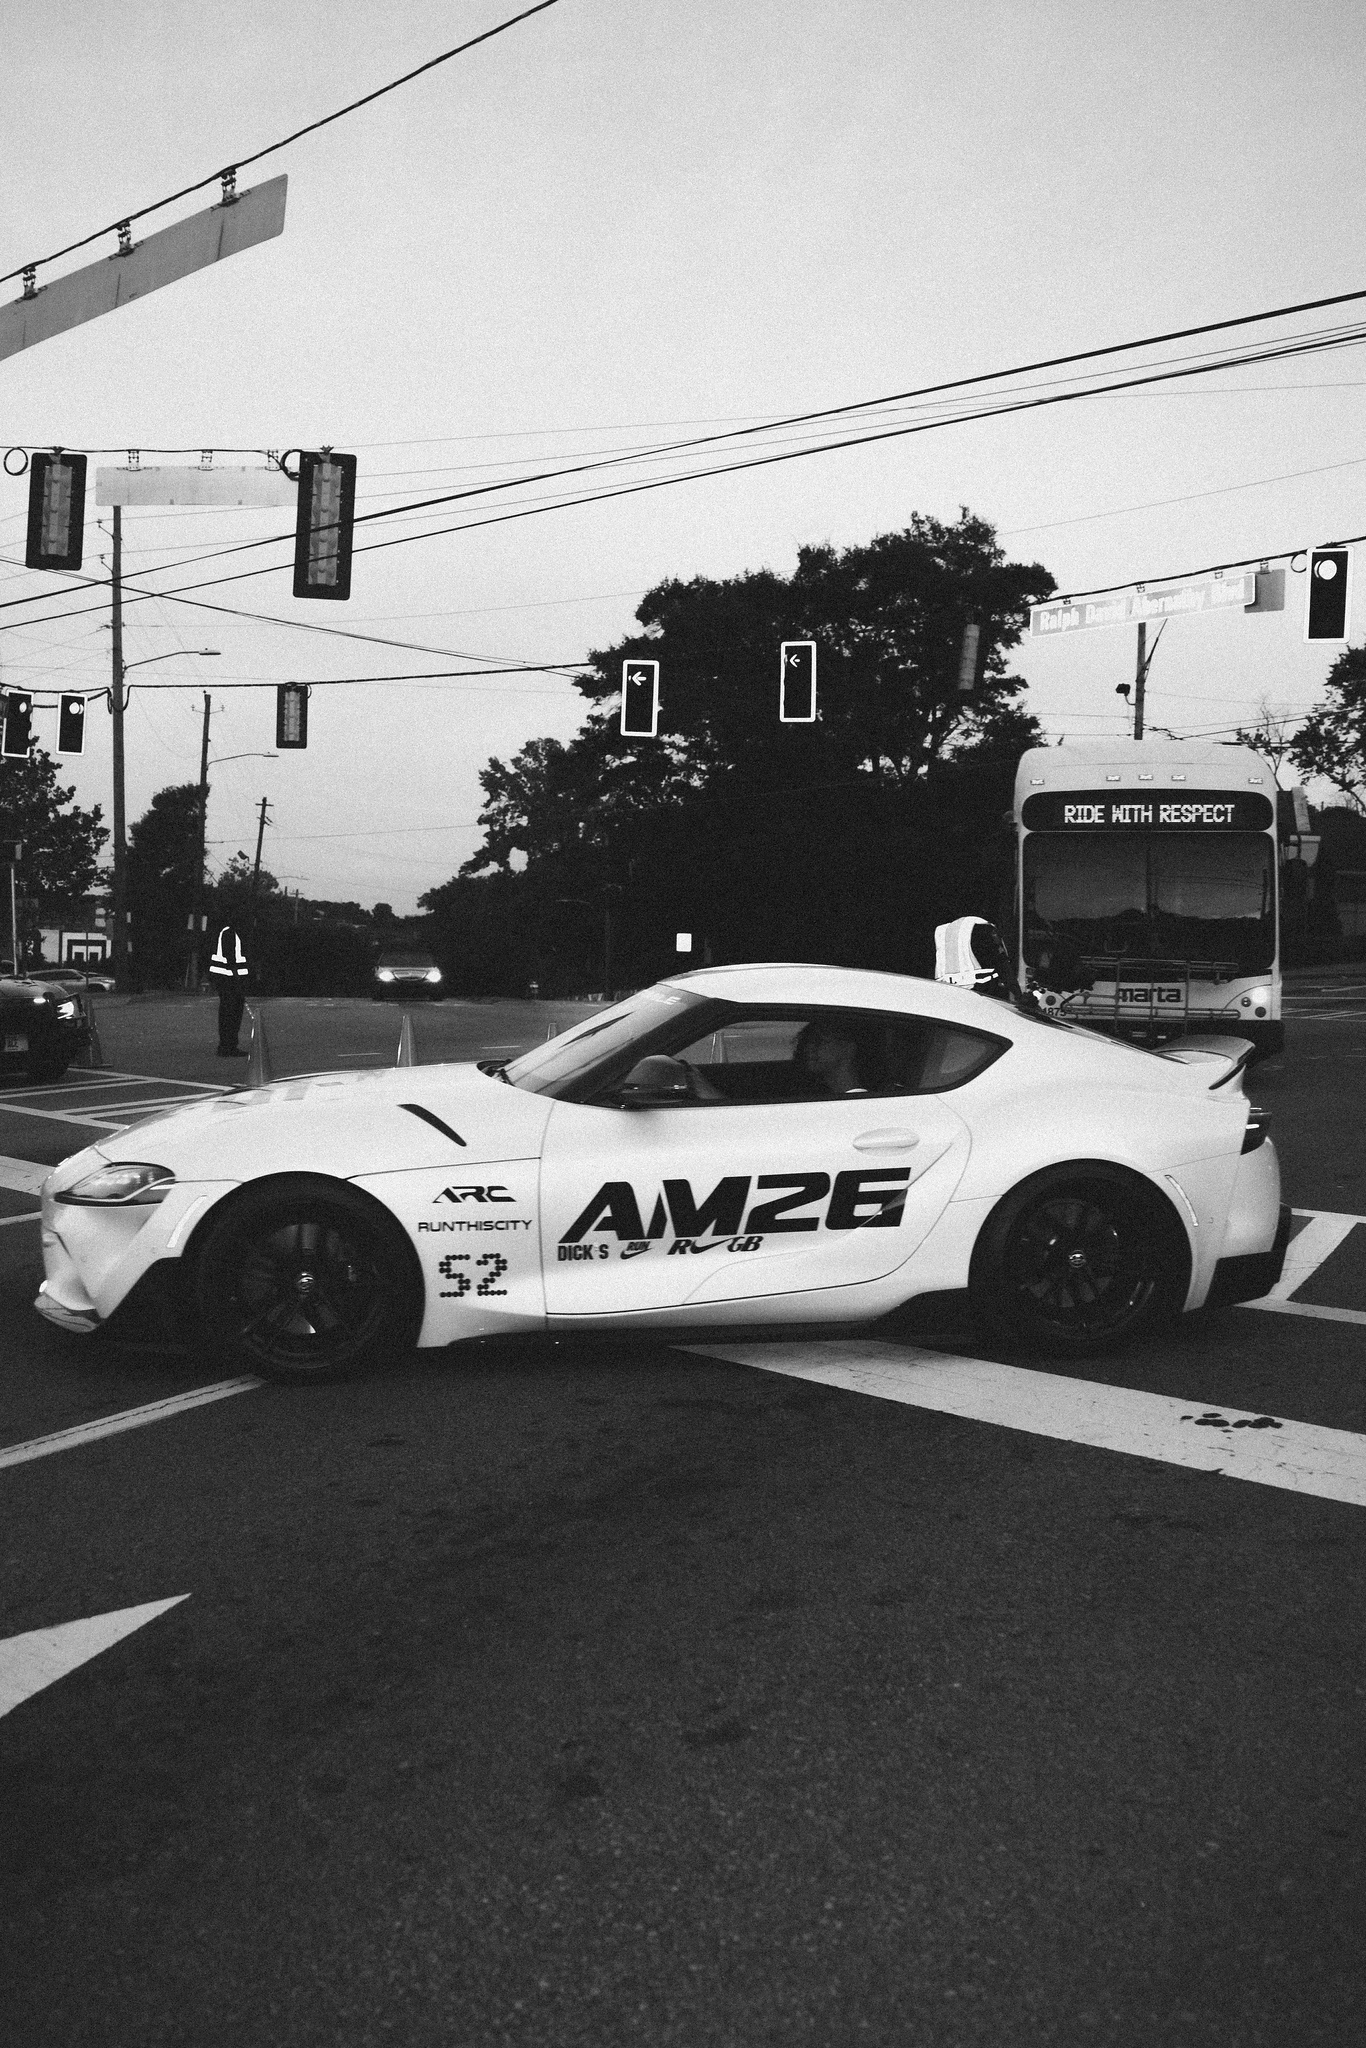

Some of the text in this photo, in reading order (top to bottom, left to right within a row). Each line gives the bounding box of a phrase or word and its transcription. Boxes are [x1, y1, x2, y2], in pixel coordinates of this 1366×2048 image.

[1039, 607, 1080, 631] Ralph
[1064, 804, 1235, 823] RIDE WITH RESPECT
[1117, 986, 1182, 1003] marta
[432, 1185, 517, 1203] ARC
[418, 1219, 533, 1233] RUNTHISCITY
